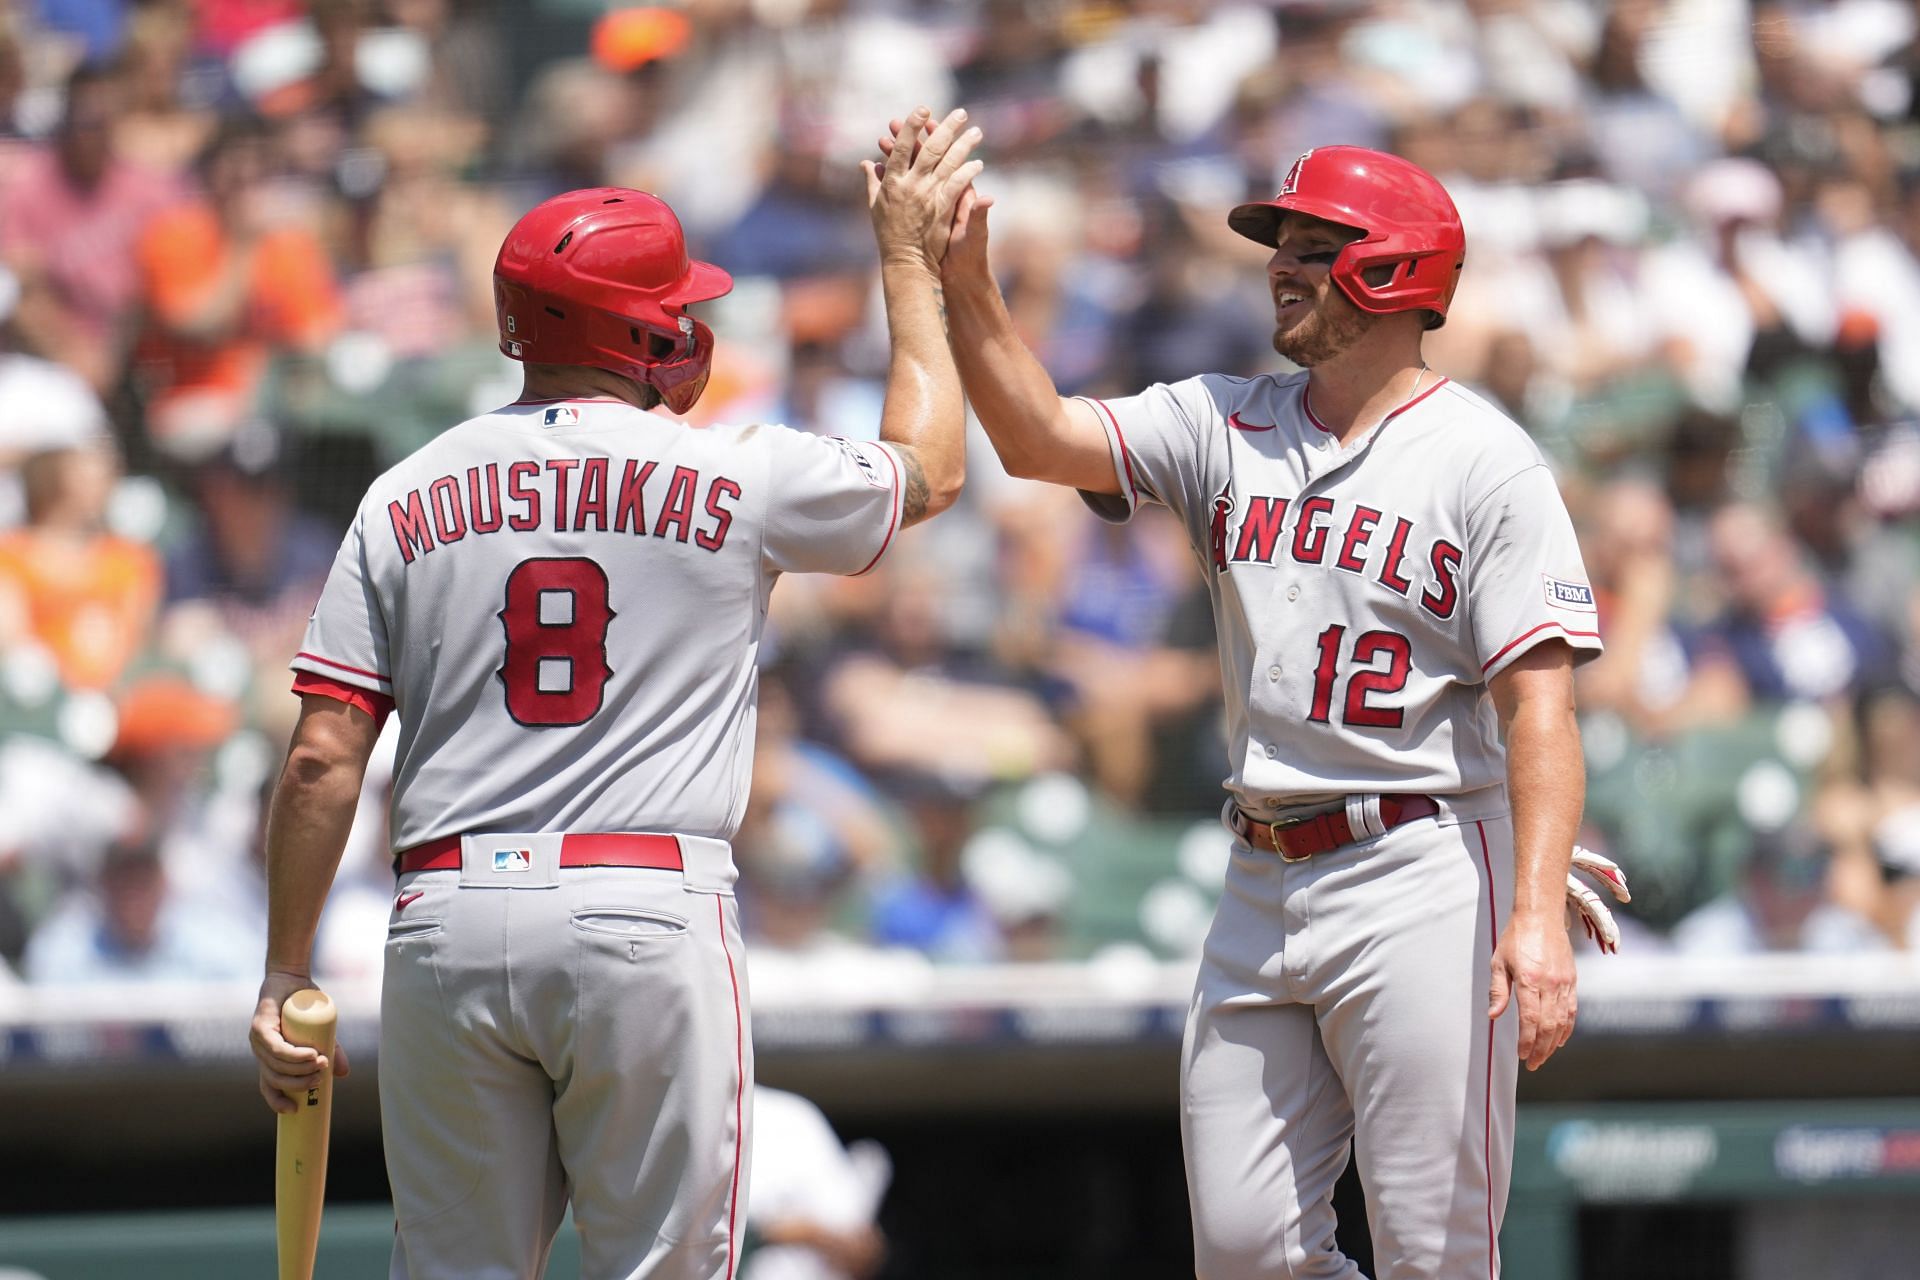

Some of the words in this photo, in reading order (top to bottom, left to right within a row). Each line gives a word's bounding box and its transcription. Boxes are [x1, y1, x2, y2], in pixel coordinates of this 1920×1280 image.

[507, 315, 516, 334] 8
[387, 457, 742, 565] MOUSTAKAS
[1210, 477, 1464, 620] ANGELS
[496, 556, 617, 728] 8
[1556, 584, 1589, 603] FBM
[1306, 623, 1413, 729] 12
